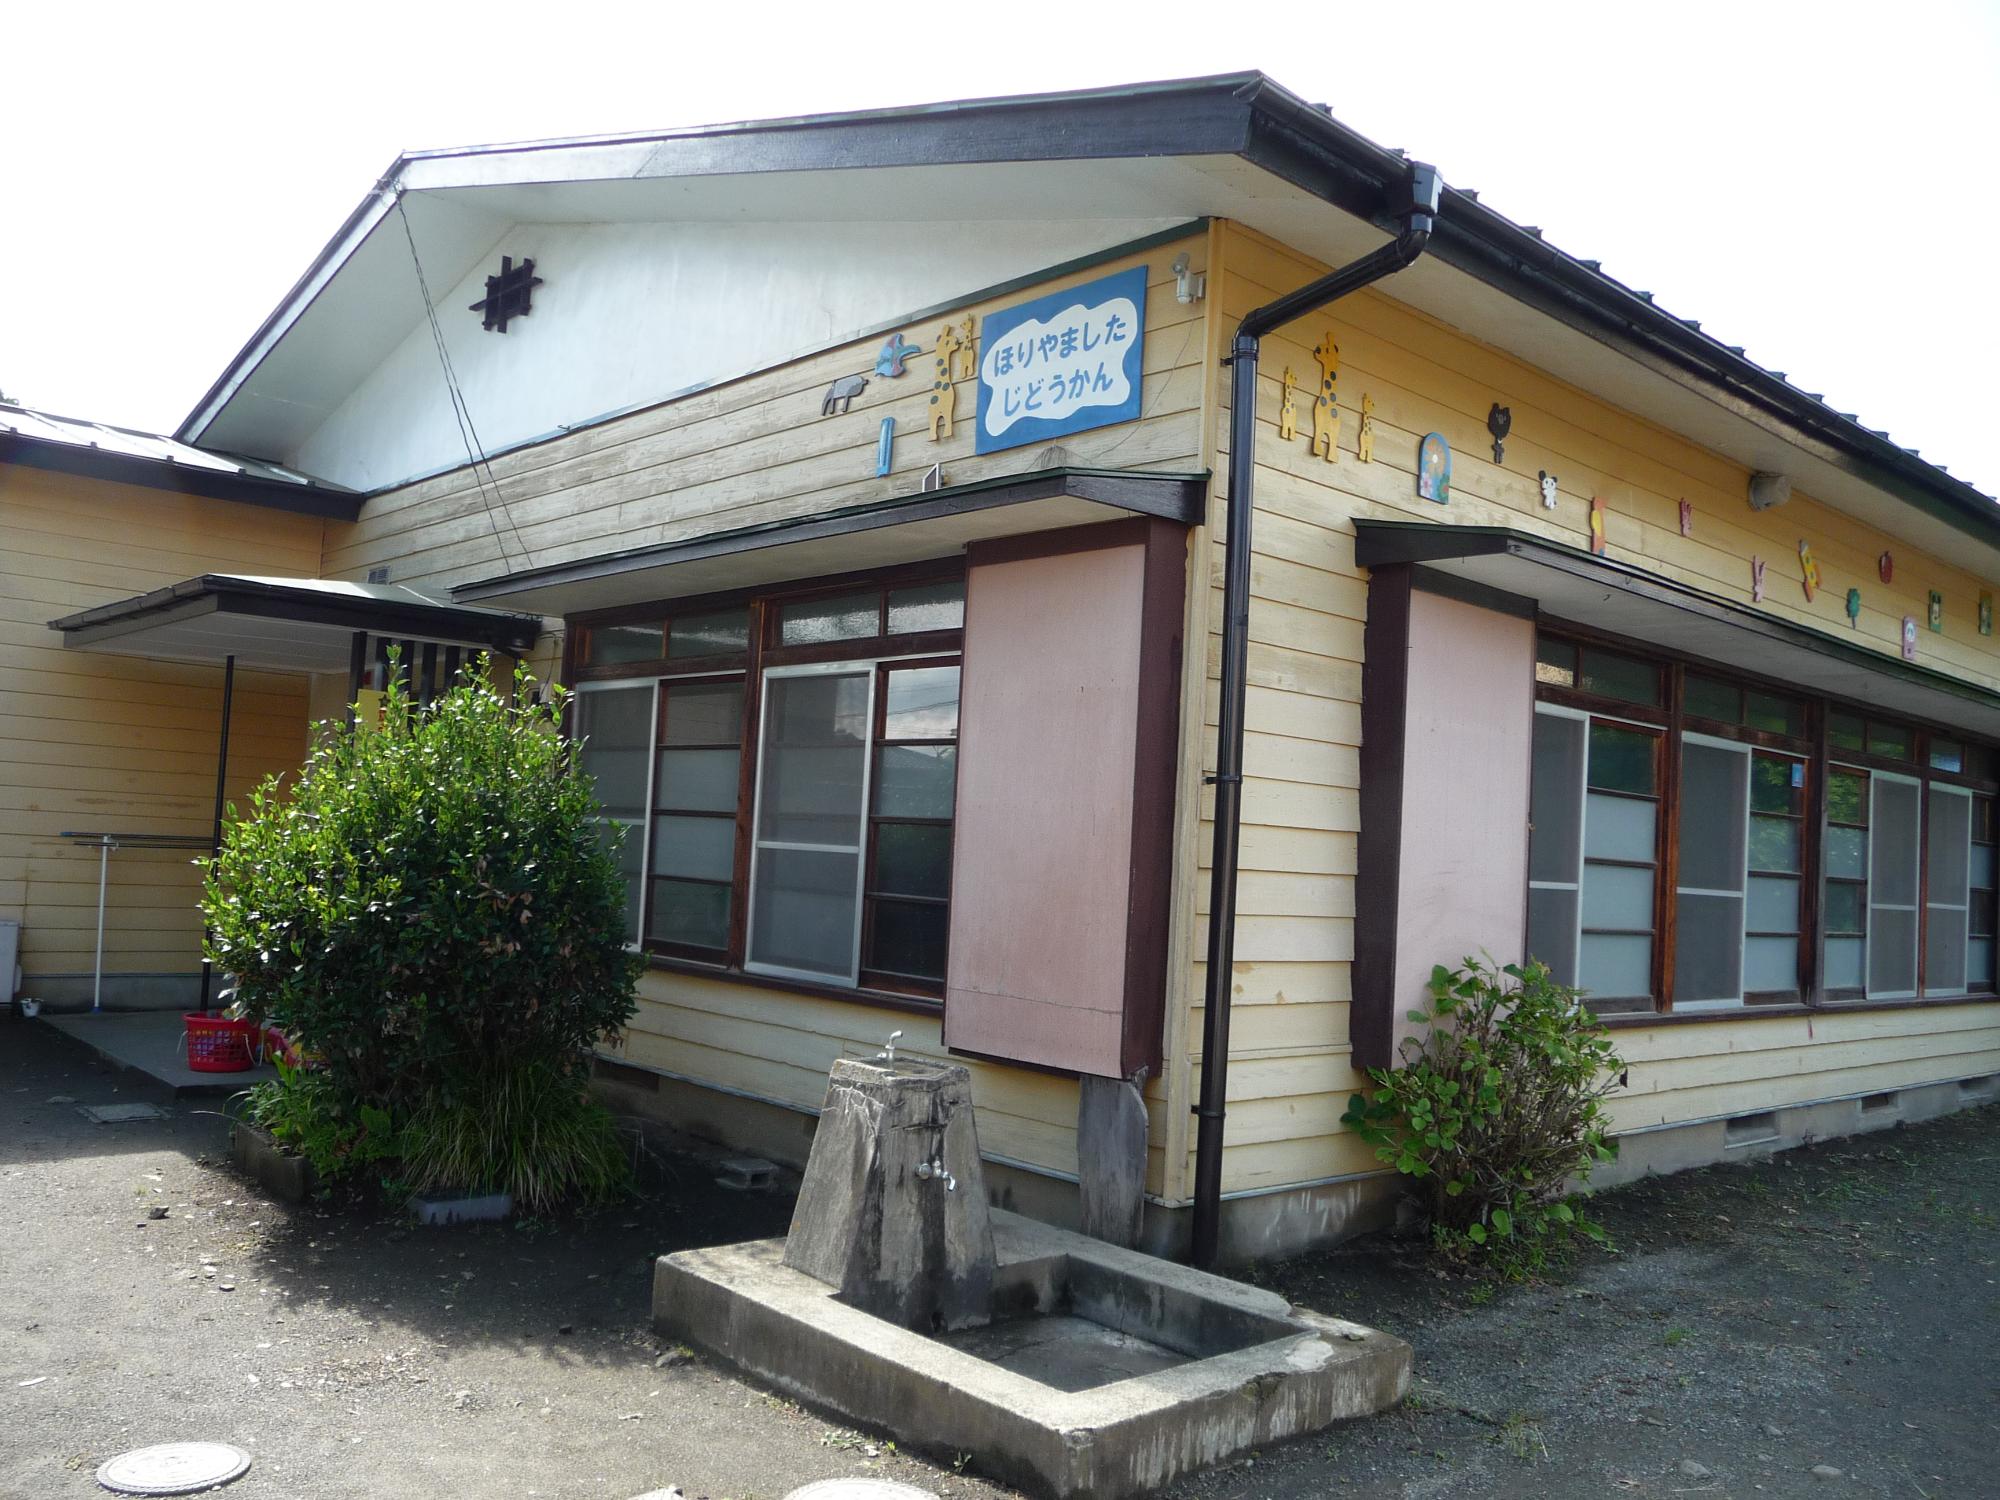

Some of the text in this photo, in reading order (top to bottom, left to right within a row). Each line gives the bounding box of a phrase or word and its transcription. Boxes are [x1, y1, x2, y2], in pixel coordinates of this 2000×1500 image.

[994, 314, 1126, 377] ほりやました
[1004, 362, 1114, 416] じどうかん
